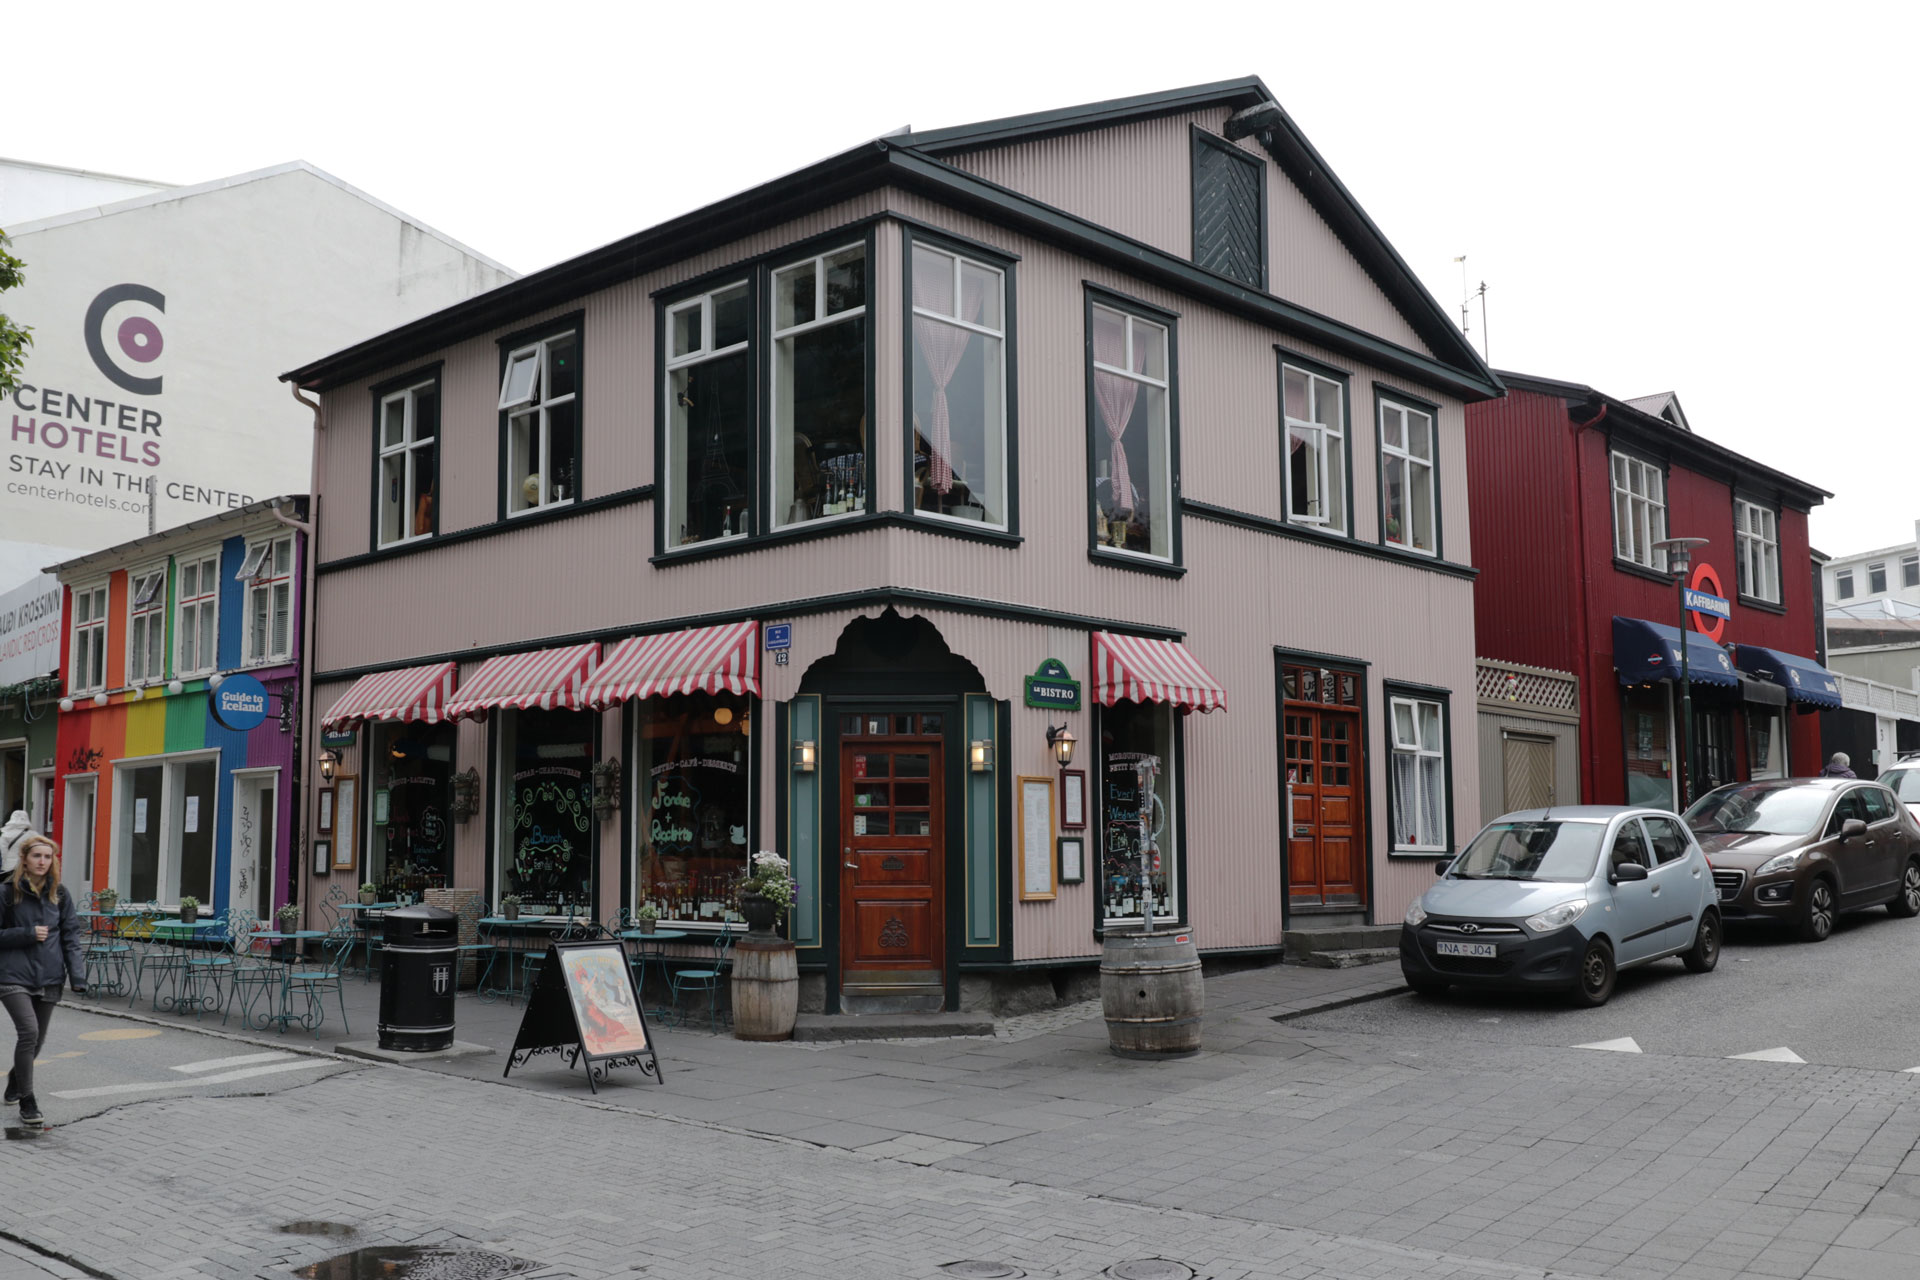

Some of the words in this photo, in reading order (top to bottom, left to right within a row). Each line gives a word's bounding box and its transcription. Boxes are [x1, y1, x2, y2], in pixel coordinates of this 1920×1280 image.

[13, 384, 162, 436] CENTER
[11, 415, 161, 467] HOTELS
[9, 454, 71, 480] STAY
[80, 466, 103, 486] IN
[777, 653, 787, 663] 12
[222, 691, 252, 703] Guide
[253, 694, 264, 703] to
[1040, 687, 1074, 700] BISTRO
[222, 700, 263, 713] Iceland
[1444, 944, 1460, 954] NA
